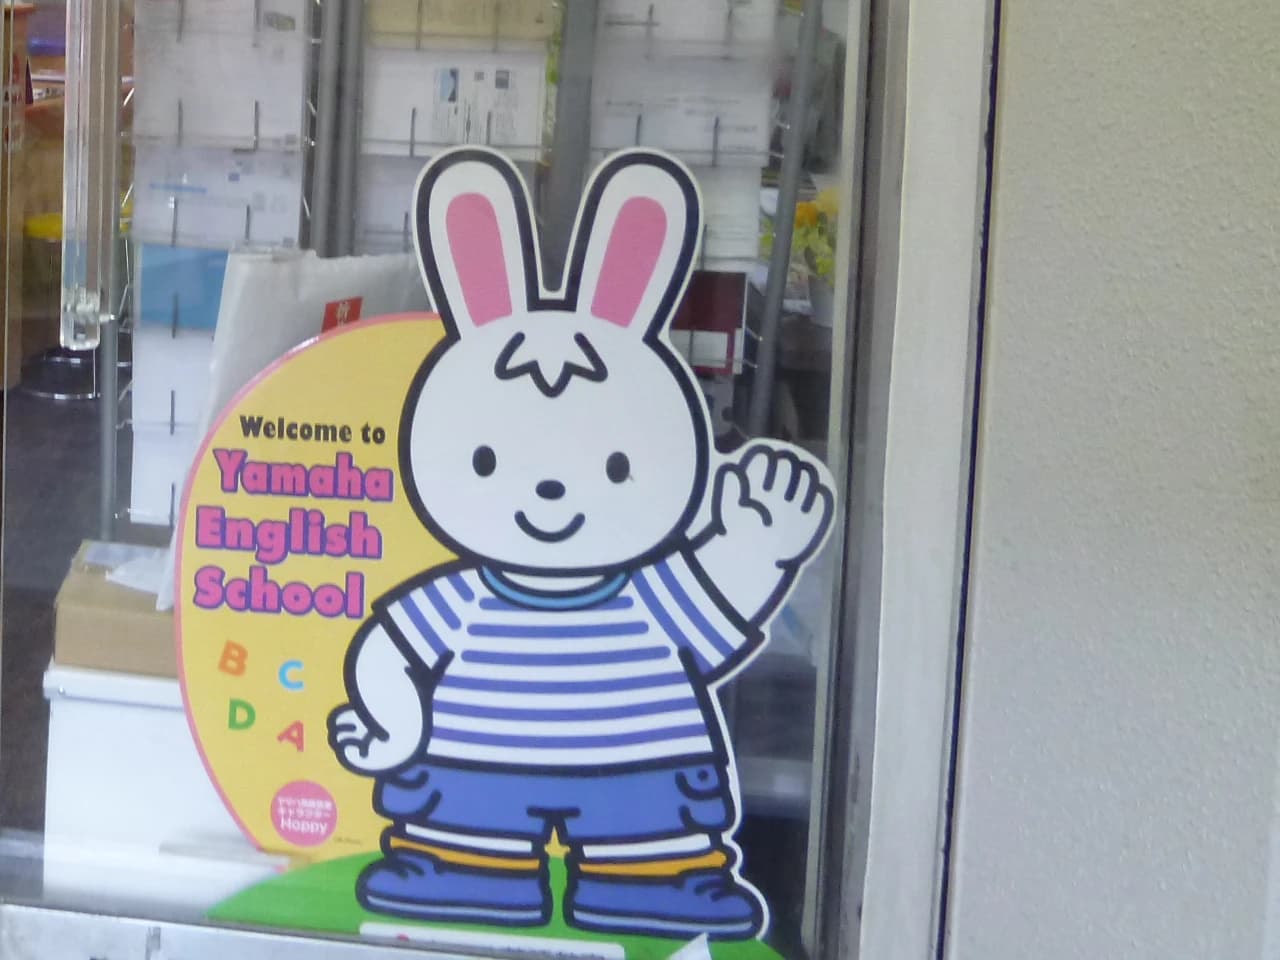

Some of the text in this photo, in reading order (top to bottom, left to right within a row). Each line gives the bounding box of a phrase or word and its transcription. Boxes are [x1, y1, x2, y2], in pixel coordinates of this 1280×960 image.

[239, 414, 386, 444] Welcome to
[212, 448, 394, 502] Yamaha
[195, 504, 383, 565] English
[193, 564, 365, 620] School
